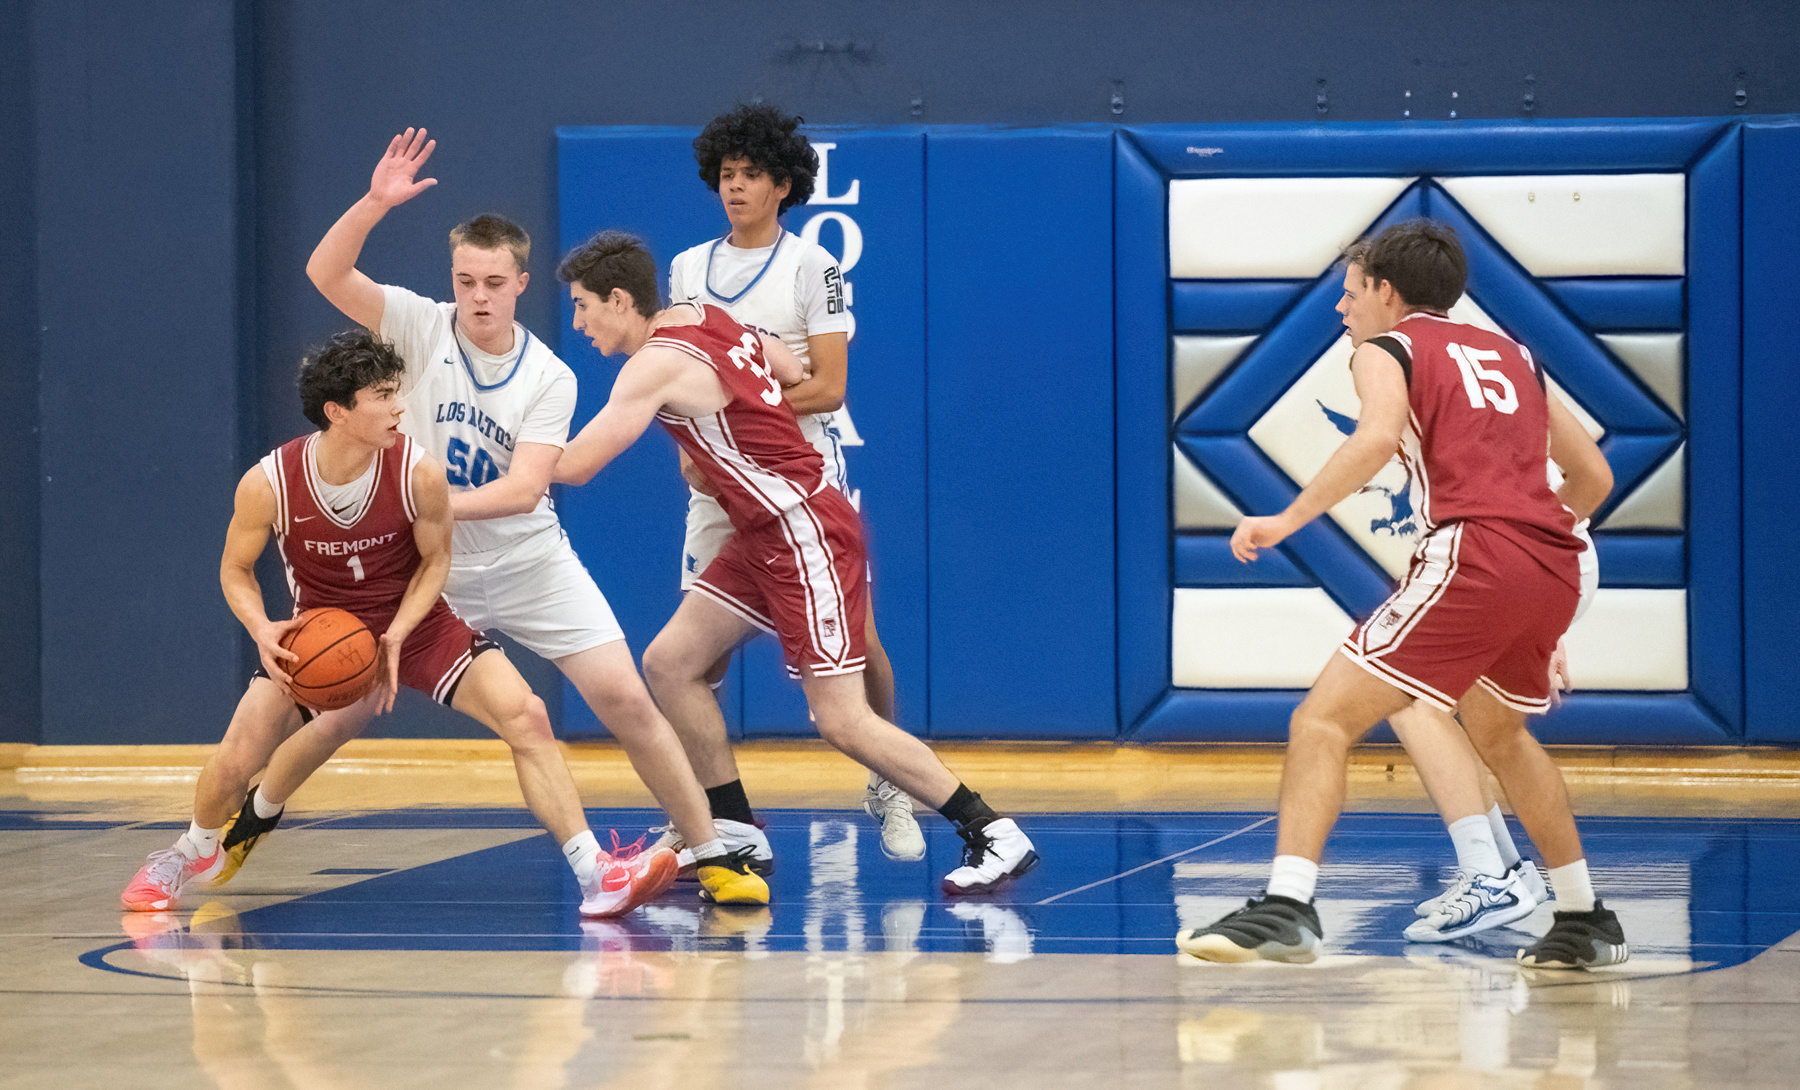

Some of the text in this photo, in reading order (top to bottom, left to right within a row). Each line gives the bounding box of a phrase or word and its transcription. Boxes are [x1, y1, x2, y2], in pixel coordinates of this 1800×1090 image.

[1445, 341, 1520, 415] 15
[435, 401, 514, 452] LOS ALTOS
[445, 436, 500, 488] 50
[304, 531, 398, 556] FREMONT
[346, 554, 365, 582] 1
